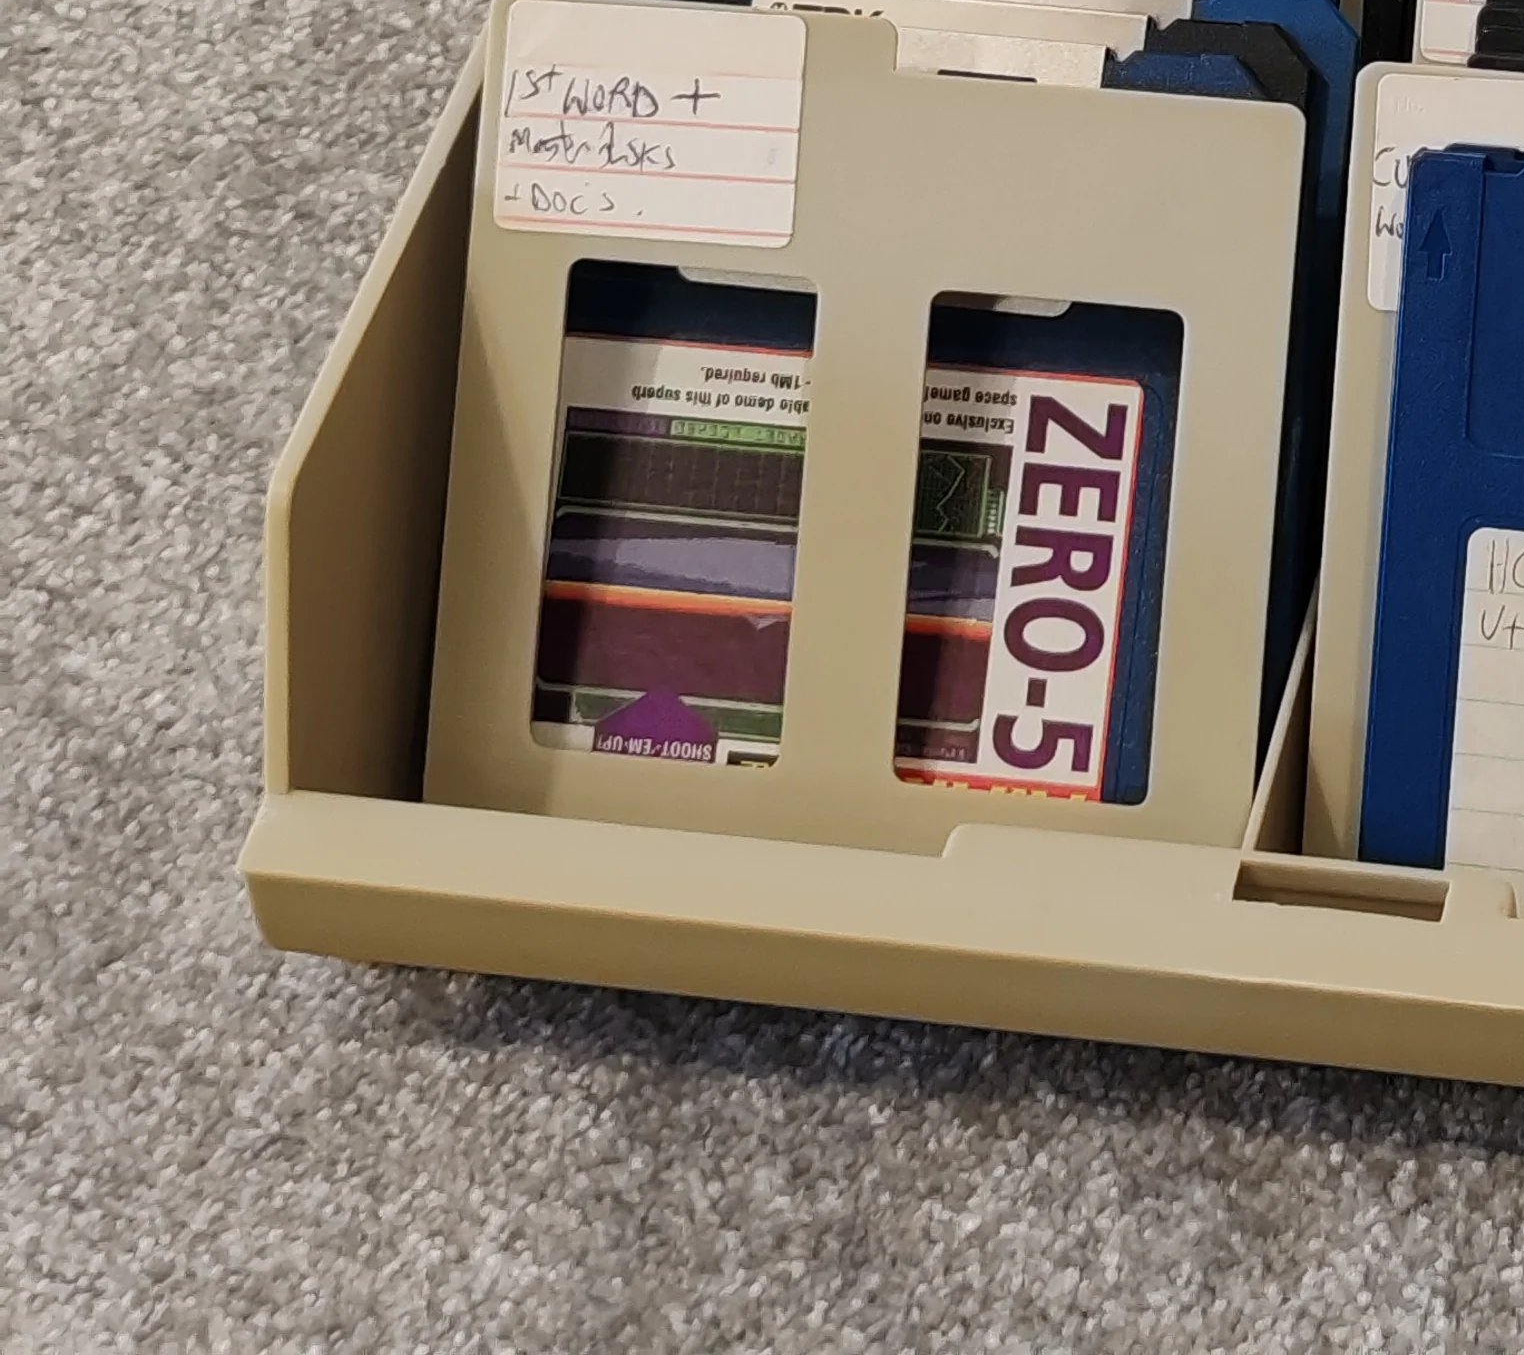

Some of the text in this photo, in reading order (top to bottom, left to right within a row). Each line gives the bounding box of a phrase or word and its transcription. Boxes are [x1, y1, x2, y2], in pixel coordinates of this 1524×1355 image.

[563, 76, 659, 118] WORD
[670, 78, 722, 115] +
[699, 366, 767, 384] required.
[631, 385, 681, 402] superb
[686, 390, 712, 408] this
[716, 392, 730, 408] of
[735, 393, 775, 412] demo
[975, 389, 1018, 407] space
[945, 413, 1015, 434] Exclusive
[991, 393, 1129, 774] ZERO-5
